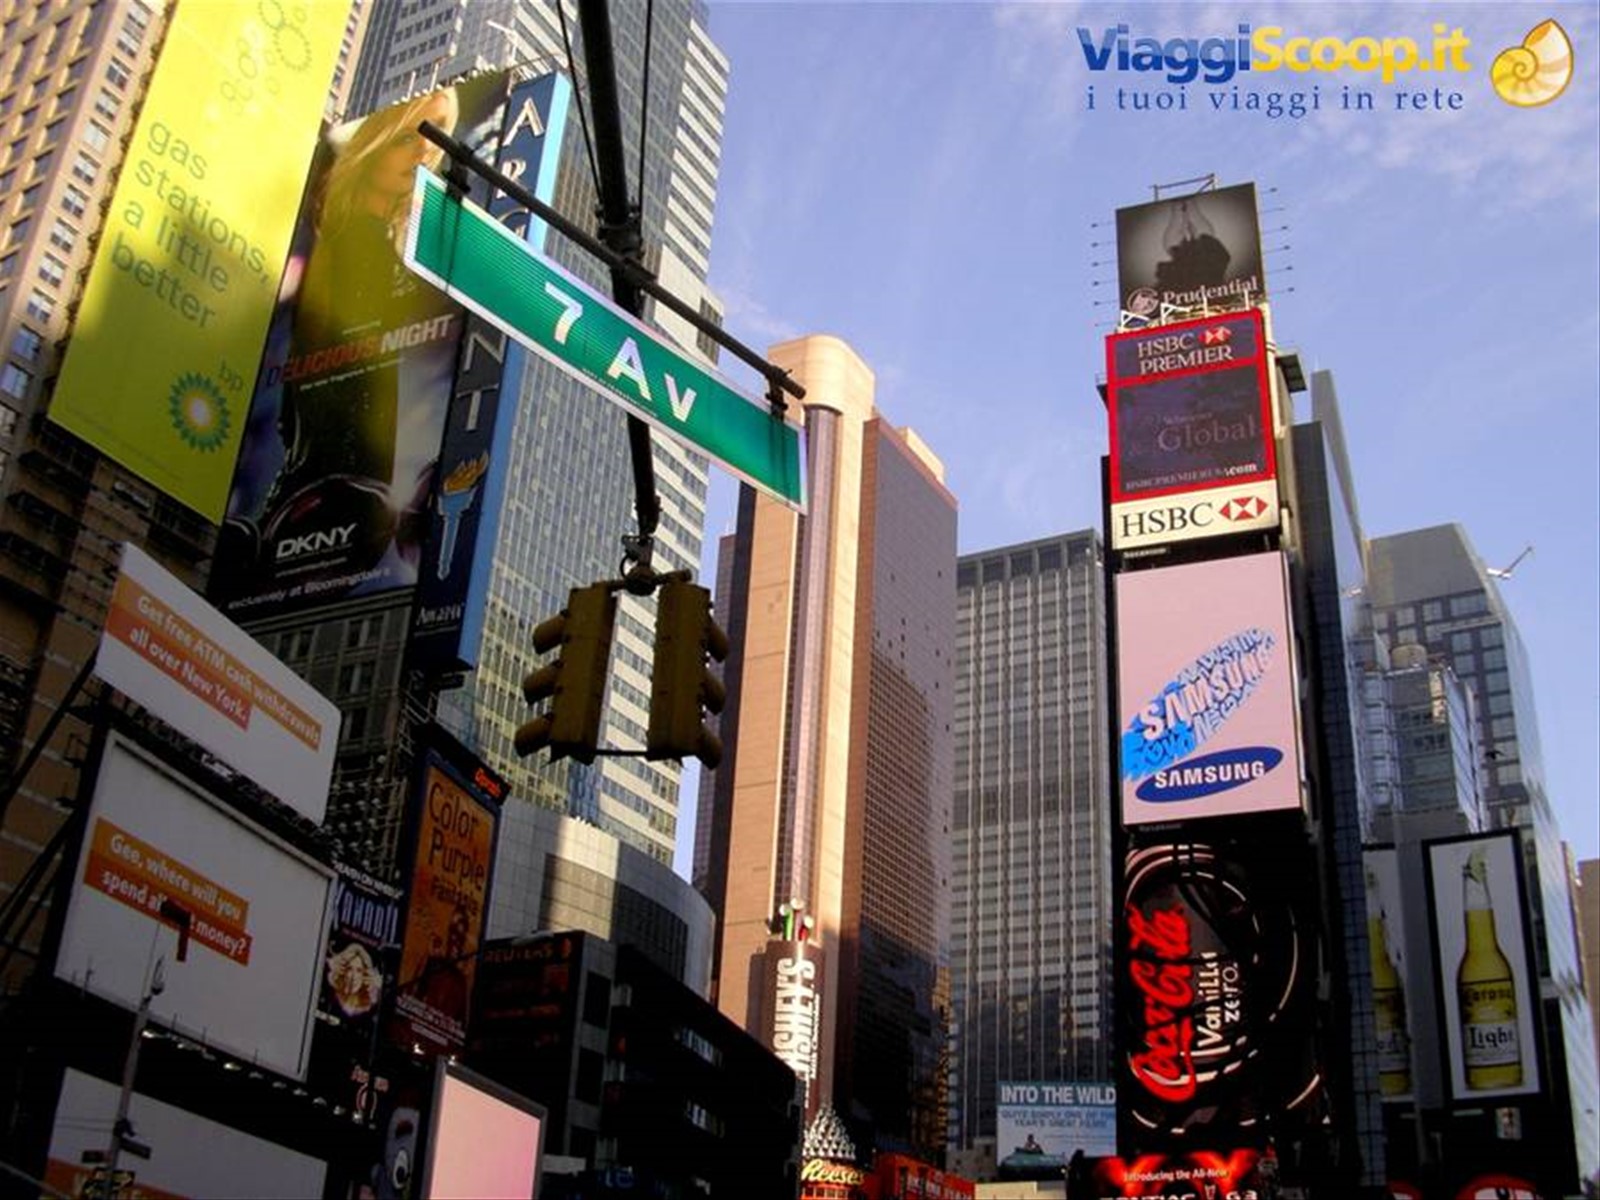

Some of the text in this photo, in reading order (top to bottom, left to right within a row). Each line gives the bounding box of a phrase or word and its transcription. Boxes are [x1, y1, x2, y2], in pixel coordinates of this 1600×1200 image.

[147, 121, 209, 181] gas
[135, 159, 270, 284] stations,
[122, 200, 230, 292] a little
[111, 231, 217, 329] better
[1162, 275, 1258, 305] Prudential
[544, 281, 584, 345] 7
[380, 314, 455, 354] NIGHT
[1137, 332, 1195, 358] HSBC
[217, 360, 245, 392] bp
[1139, 345, 1234, 376] PREMIER
[1157, 413, 1257, 452] Global
[1120, 502, 1215, 538] HSBC
[275, 522, 358, 559] DKNY
[129, 626, 150, 650] all
[150, 643, 181, 671] over
[182, 660, 214, 696] New
[192, 638, 226, 671] ATM
[1154, 760, 1266, 789] SAMSUNG
[428, 781, 479, 839] Color
[427, 826, 485, 892] Purple
[145, 857, 191, 894] where
[191, 884, 219, 906] will
[216, 899, 242, 922] you
[101, 869, 149, 903] spend
[195, 919, 248, 958] money?
[1126, 902, 1197, 1103] Coca-Cola
[1469, 1027, 1516, 1050] Light
[1001, 1085, 1117, 1104] INTO THE WILD
[1123, 1170, 1175, 1183] Introducing
[1175, 1168, 1191, 1180] the
